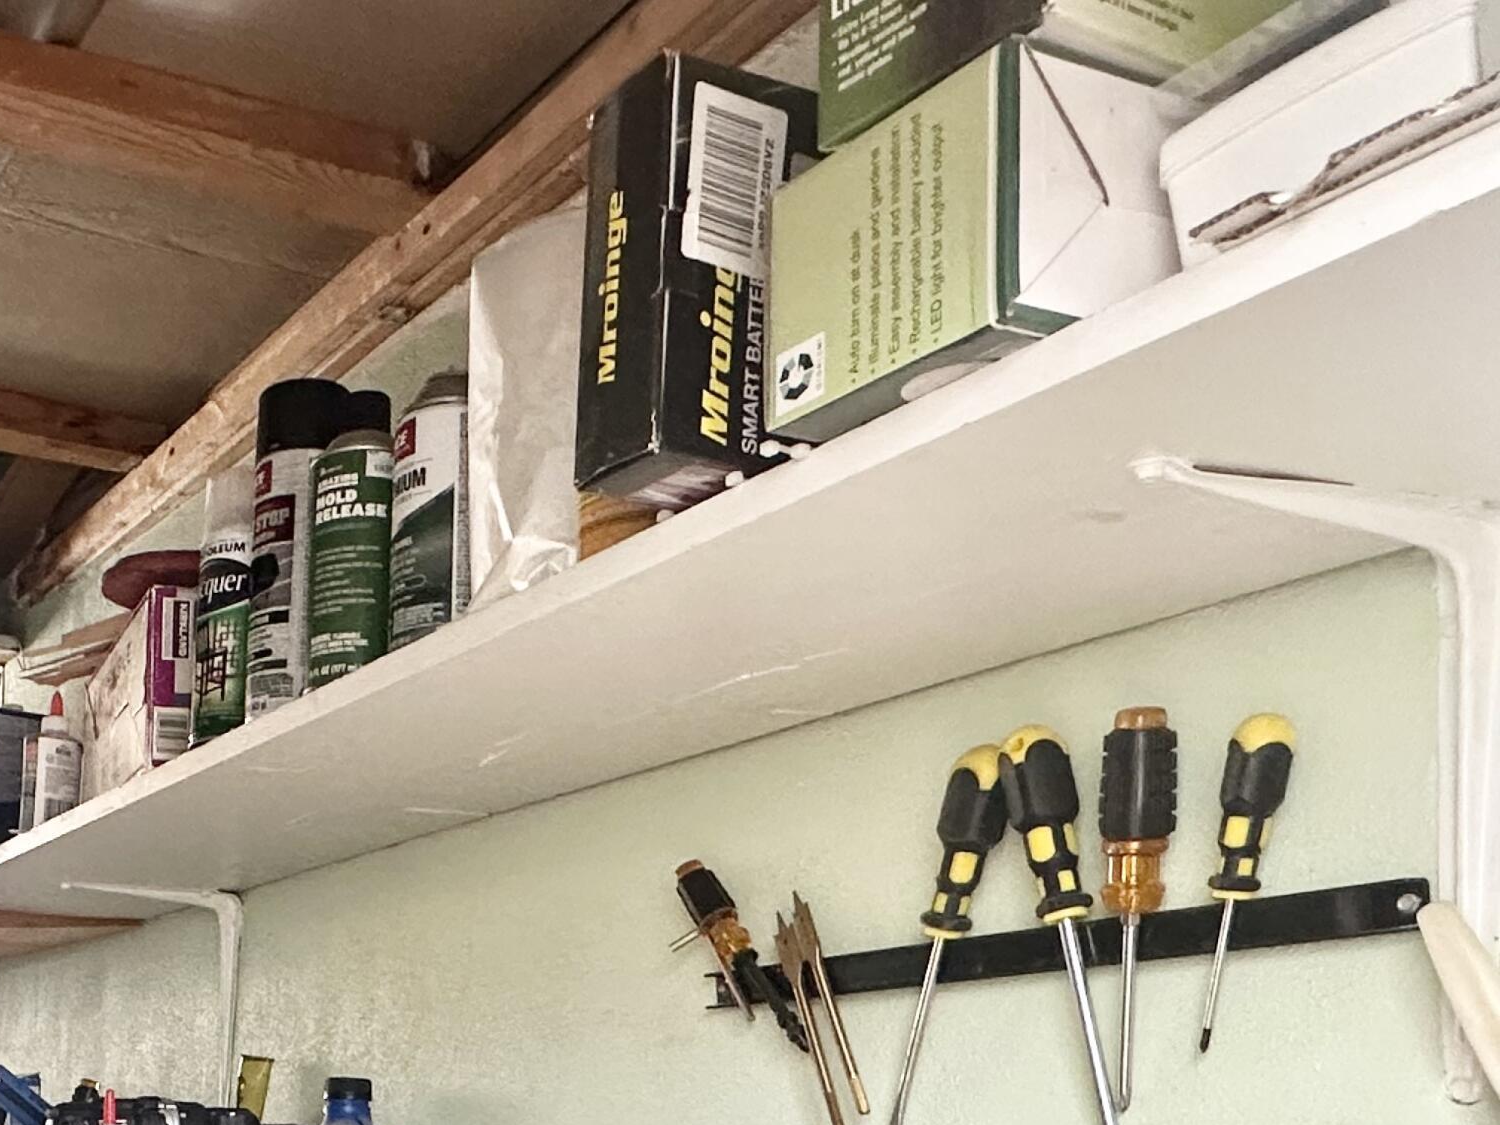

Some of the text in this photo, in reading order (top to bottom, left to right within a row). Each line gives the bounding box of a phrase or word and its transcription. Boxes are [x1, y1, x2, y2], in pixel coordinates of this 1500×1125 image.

[869, 147, 883, 208] gardens
[850, 229, 860, 263] dusk
[870, 210, 880, 240] and
[890, 209, 900, 236] and
[910, 113, 924, 343] Rechargeable battery included
[930, 124, 945, 333] LED light for brighter output
[597, 190, 628, 385] Mroinge
[851, 284, 860, 304] on
[890, 241, 902, 310] assembly
[700, 262, 742, 447] Mroing
[849, 340, 860, 373] Auto
[888, 316, 902, 354] Easy
[741, 278, 765, 455] SMART BATTE
[315, 502, 388, 526] RELEASE
